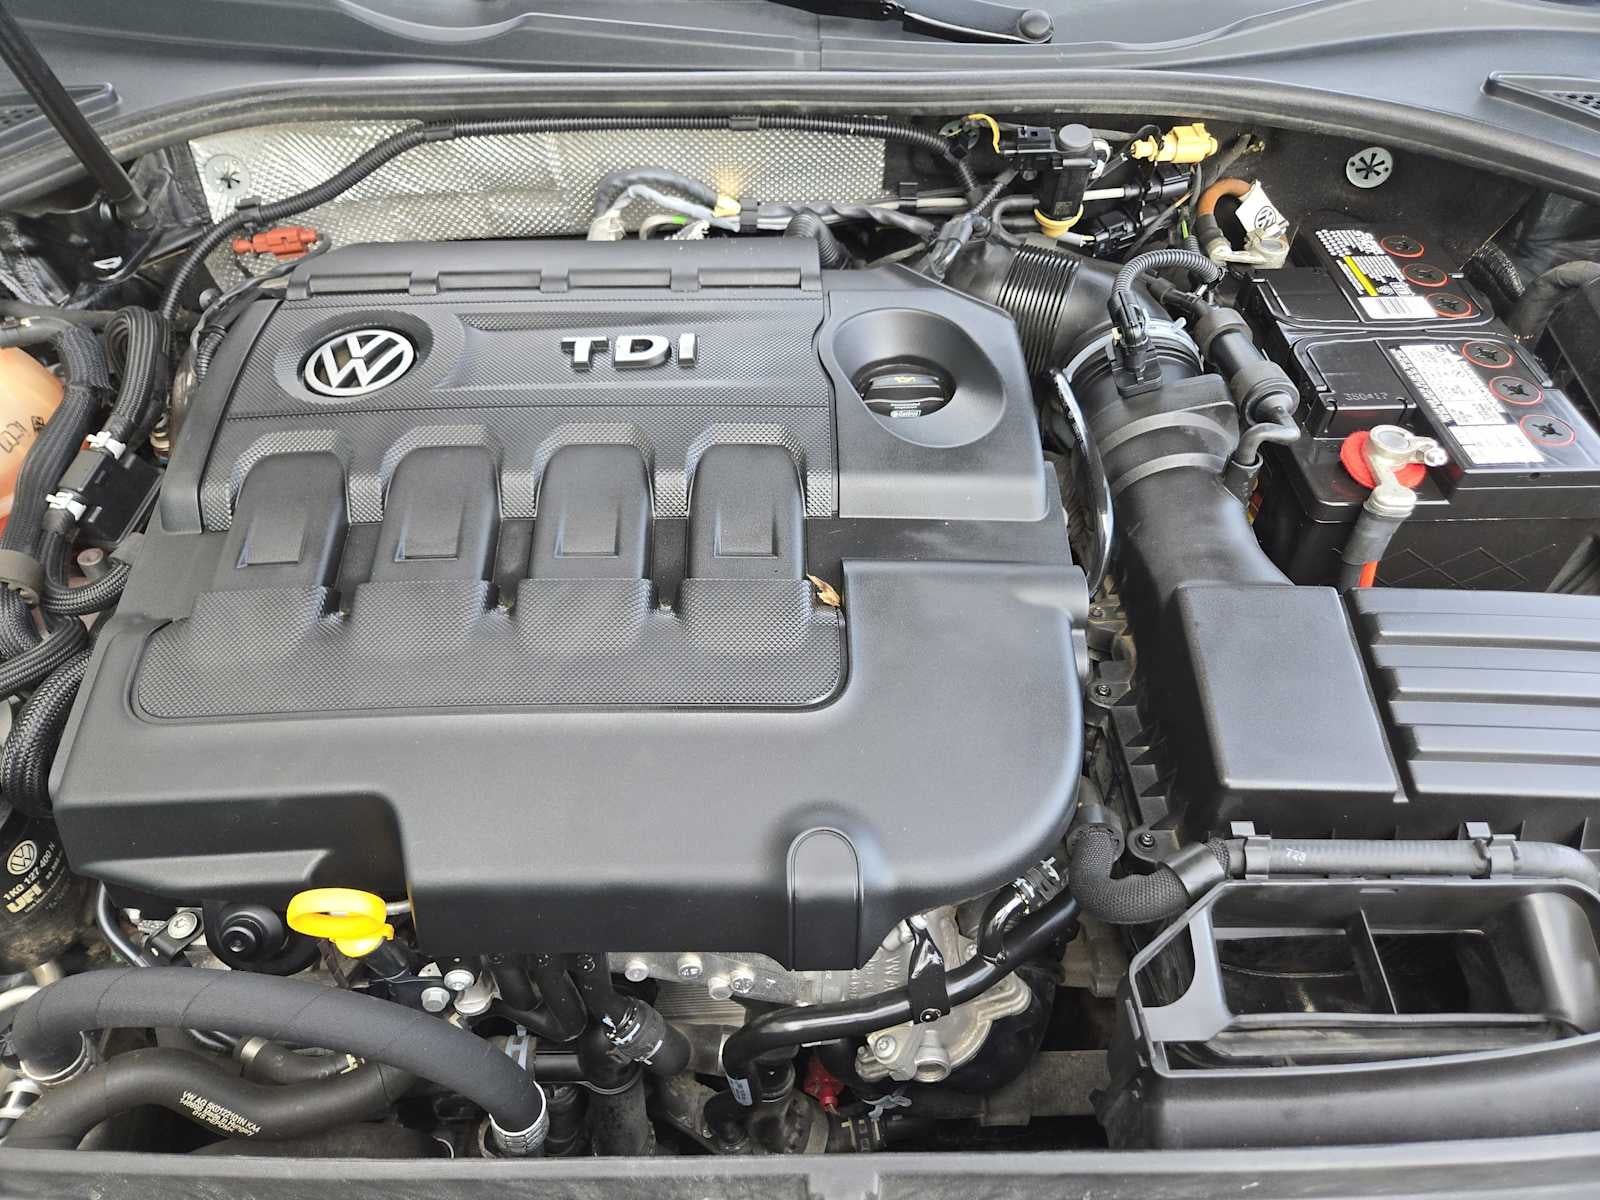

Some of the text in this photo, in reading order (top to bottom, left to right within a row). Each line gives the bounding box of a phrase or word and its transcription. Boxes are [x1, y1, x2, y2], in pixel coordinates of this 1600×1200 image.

[304, 329, 414, 396] VW
[560, 333, 700, 370] TDI
[24, 866, 40, 885] 127
[6, 883, 42, 913] UFI
